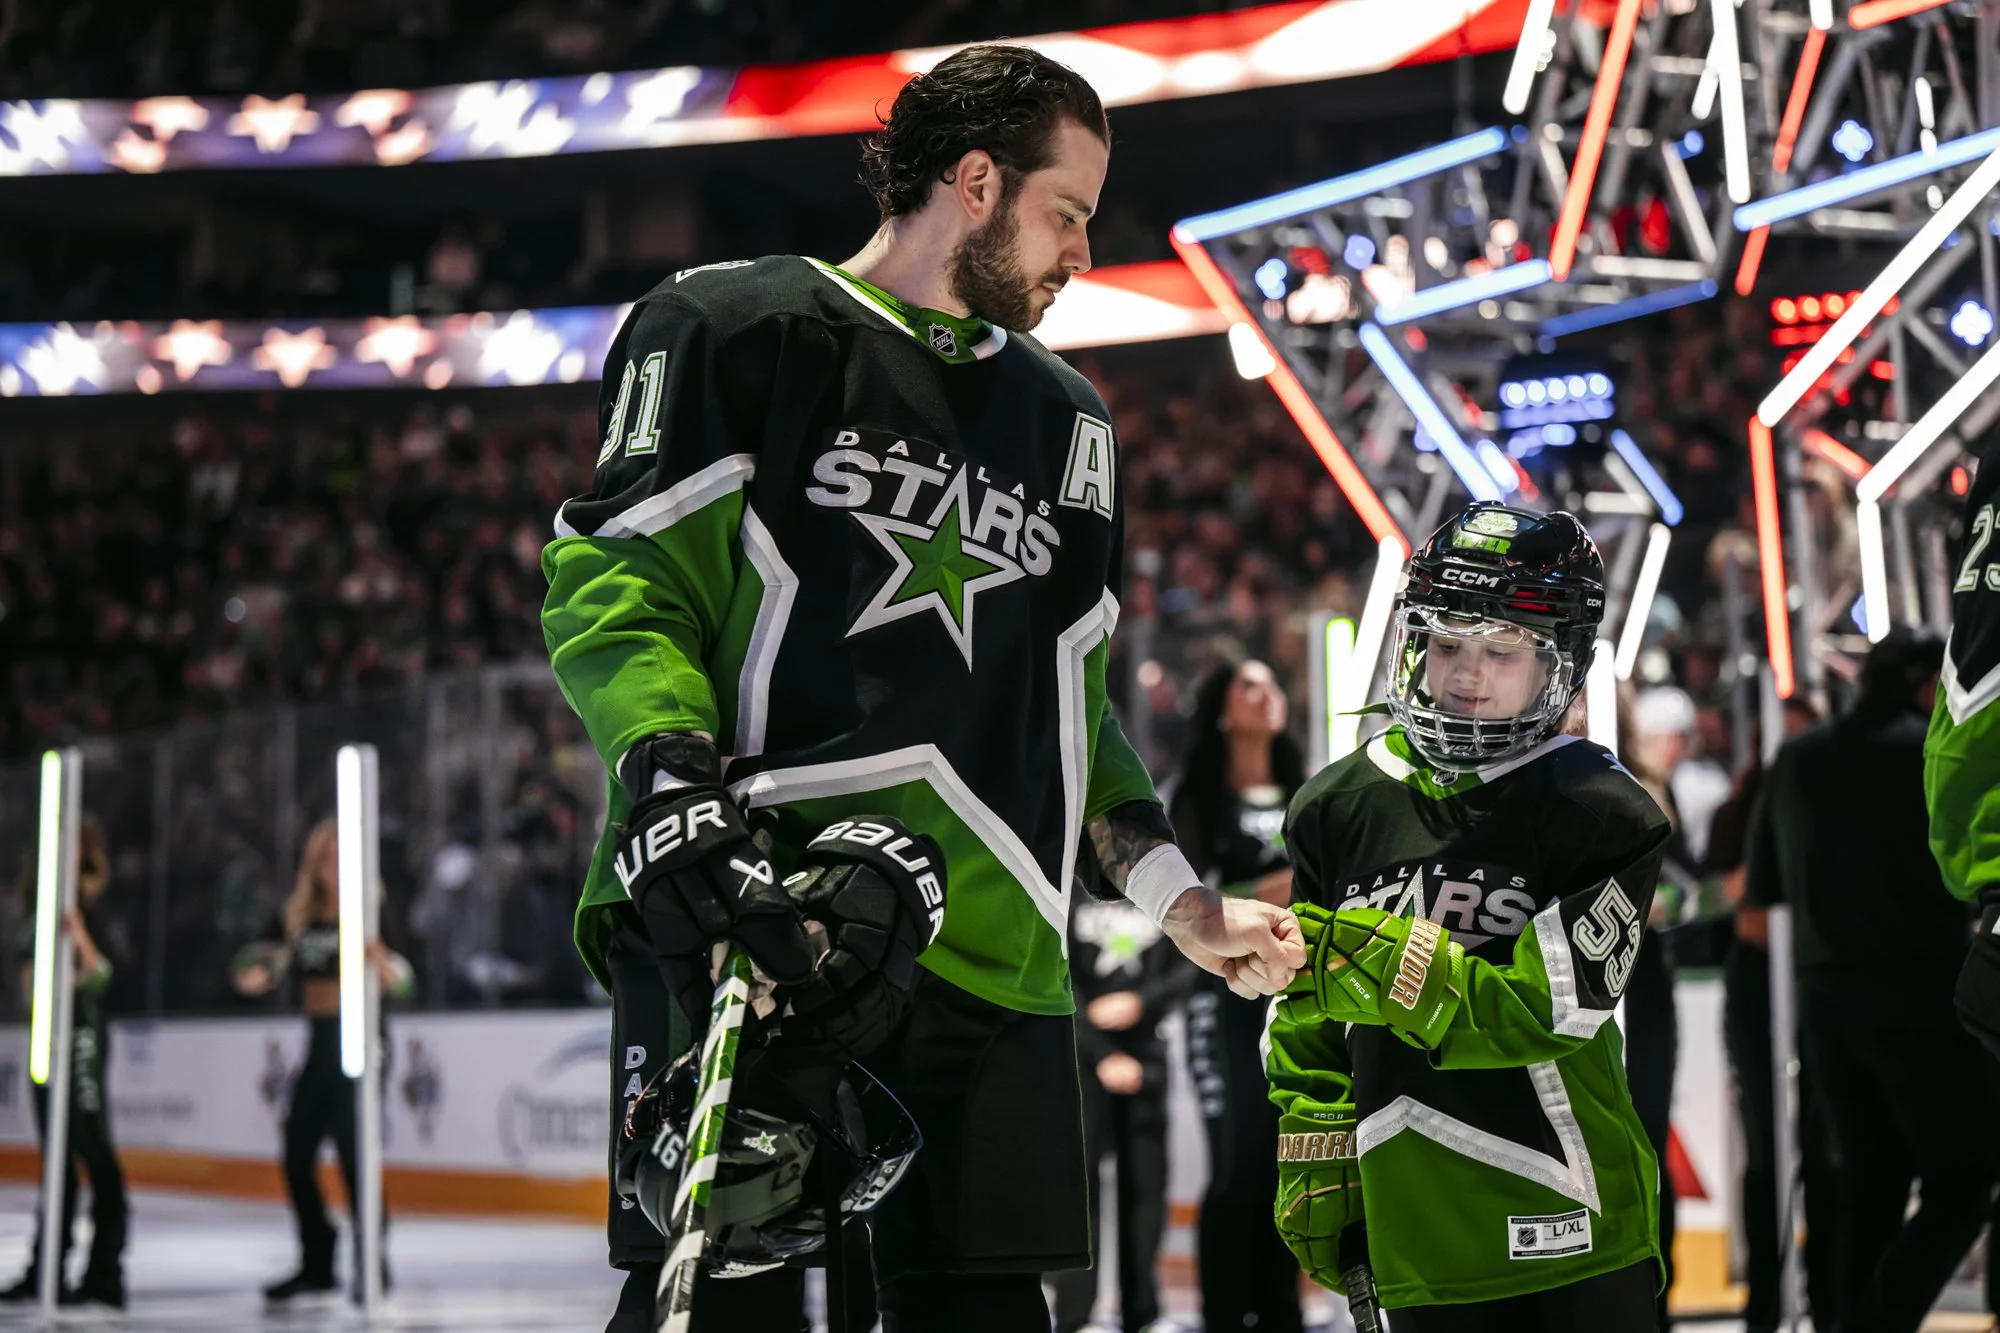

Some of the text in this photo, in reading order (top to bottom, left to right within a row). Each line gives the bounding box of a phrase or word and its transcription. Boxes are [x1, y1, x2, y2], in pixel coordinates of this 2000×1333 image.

[834, 430, 1051, 517] DALLAS
[1057, 411, 1116, 523] A
[805, 449, 1061, 577] STARS
[1441, 568, 1500, 588] CCM
[1346, 864, 1527, 897] DALLAS
[1572, 876, 1640, 998] 53
[1553, 1220, 1584, 1237] L/XL
